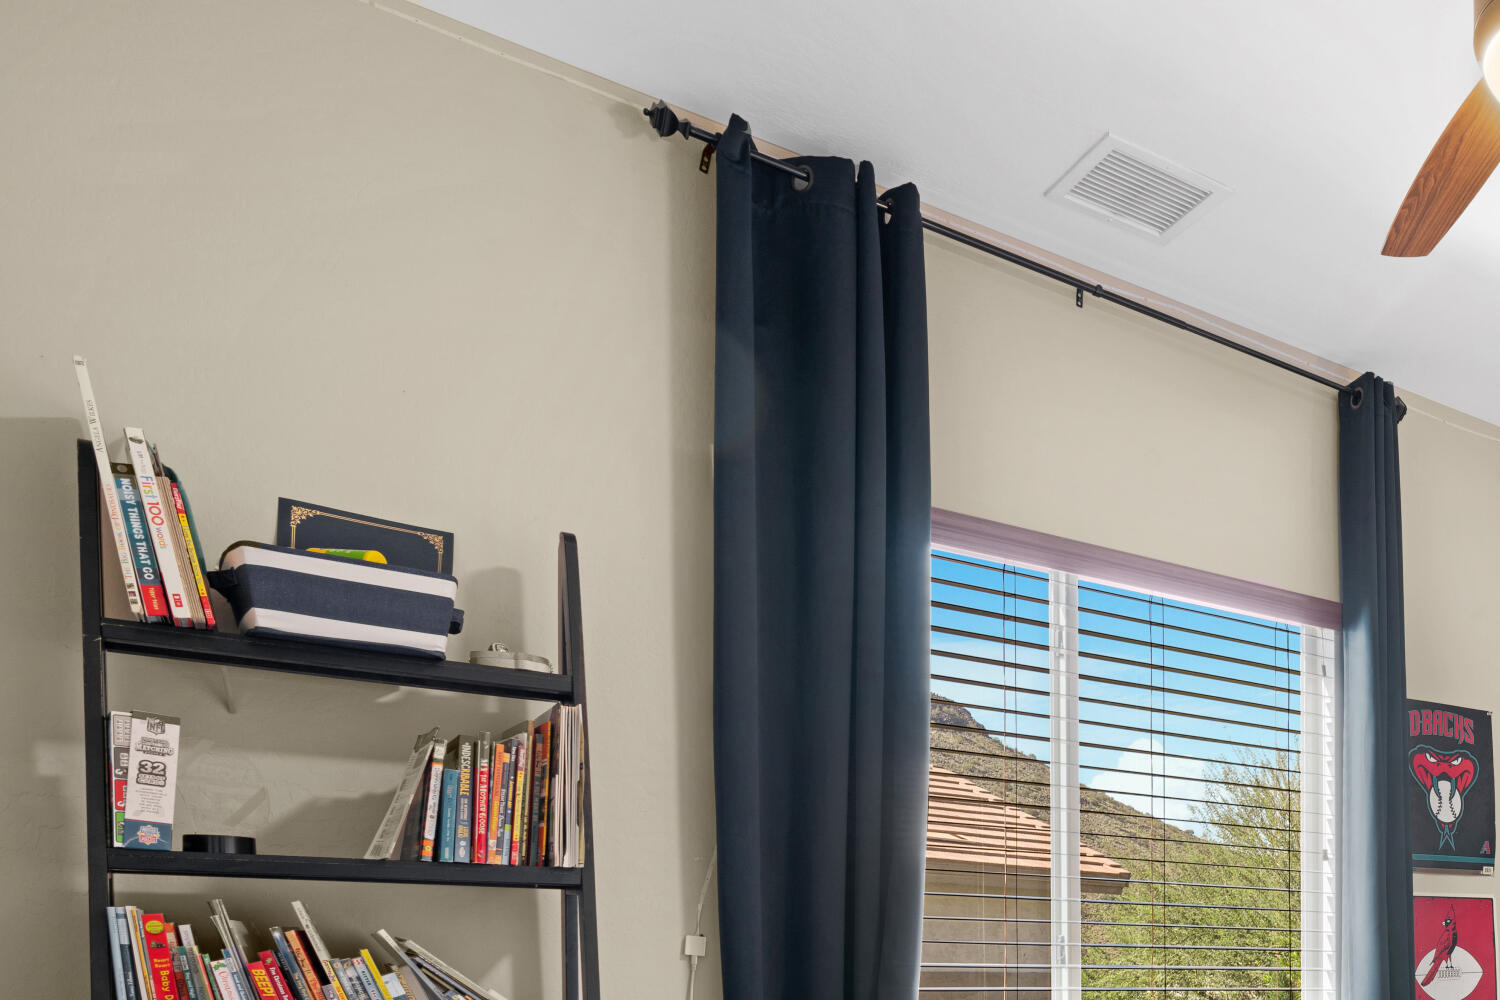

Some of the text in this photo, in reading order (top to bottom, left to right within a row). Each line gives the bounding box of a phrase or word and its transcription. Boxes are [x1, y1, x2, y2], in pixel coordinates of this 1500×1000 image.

[140, 473, 156, 500] First
[120, 477, 153, 580] NOISY THINGS THAT GO
[147, 500, 164, 527] 100
[1408, 709, 1475, 745] D-BACKS
[139, 760, 166, 775] 32
[459, 744, 471, 795] INDESCRIBABLE
[159, 969, 172, 992] Baby
[251, 965, 274, 999] BEEP!
